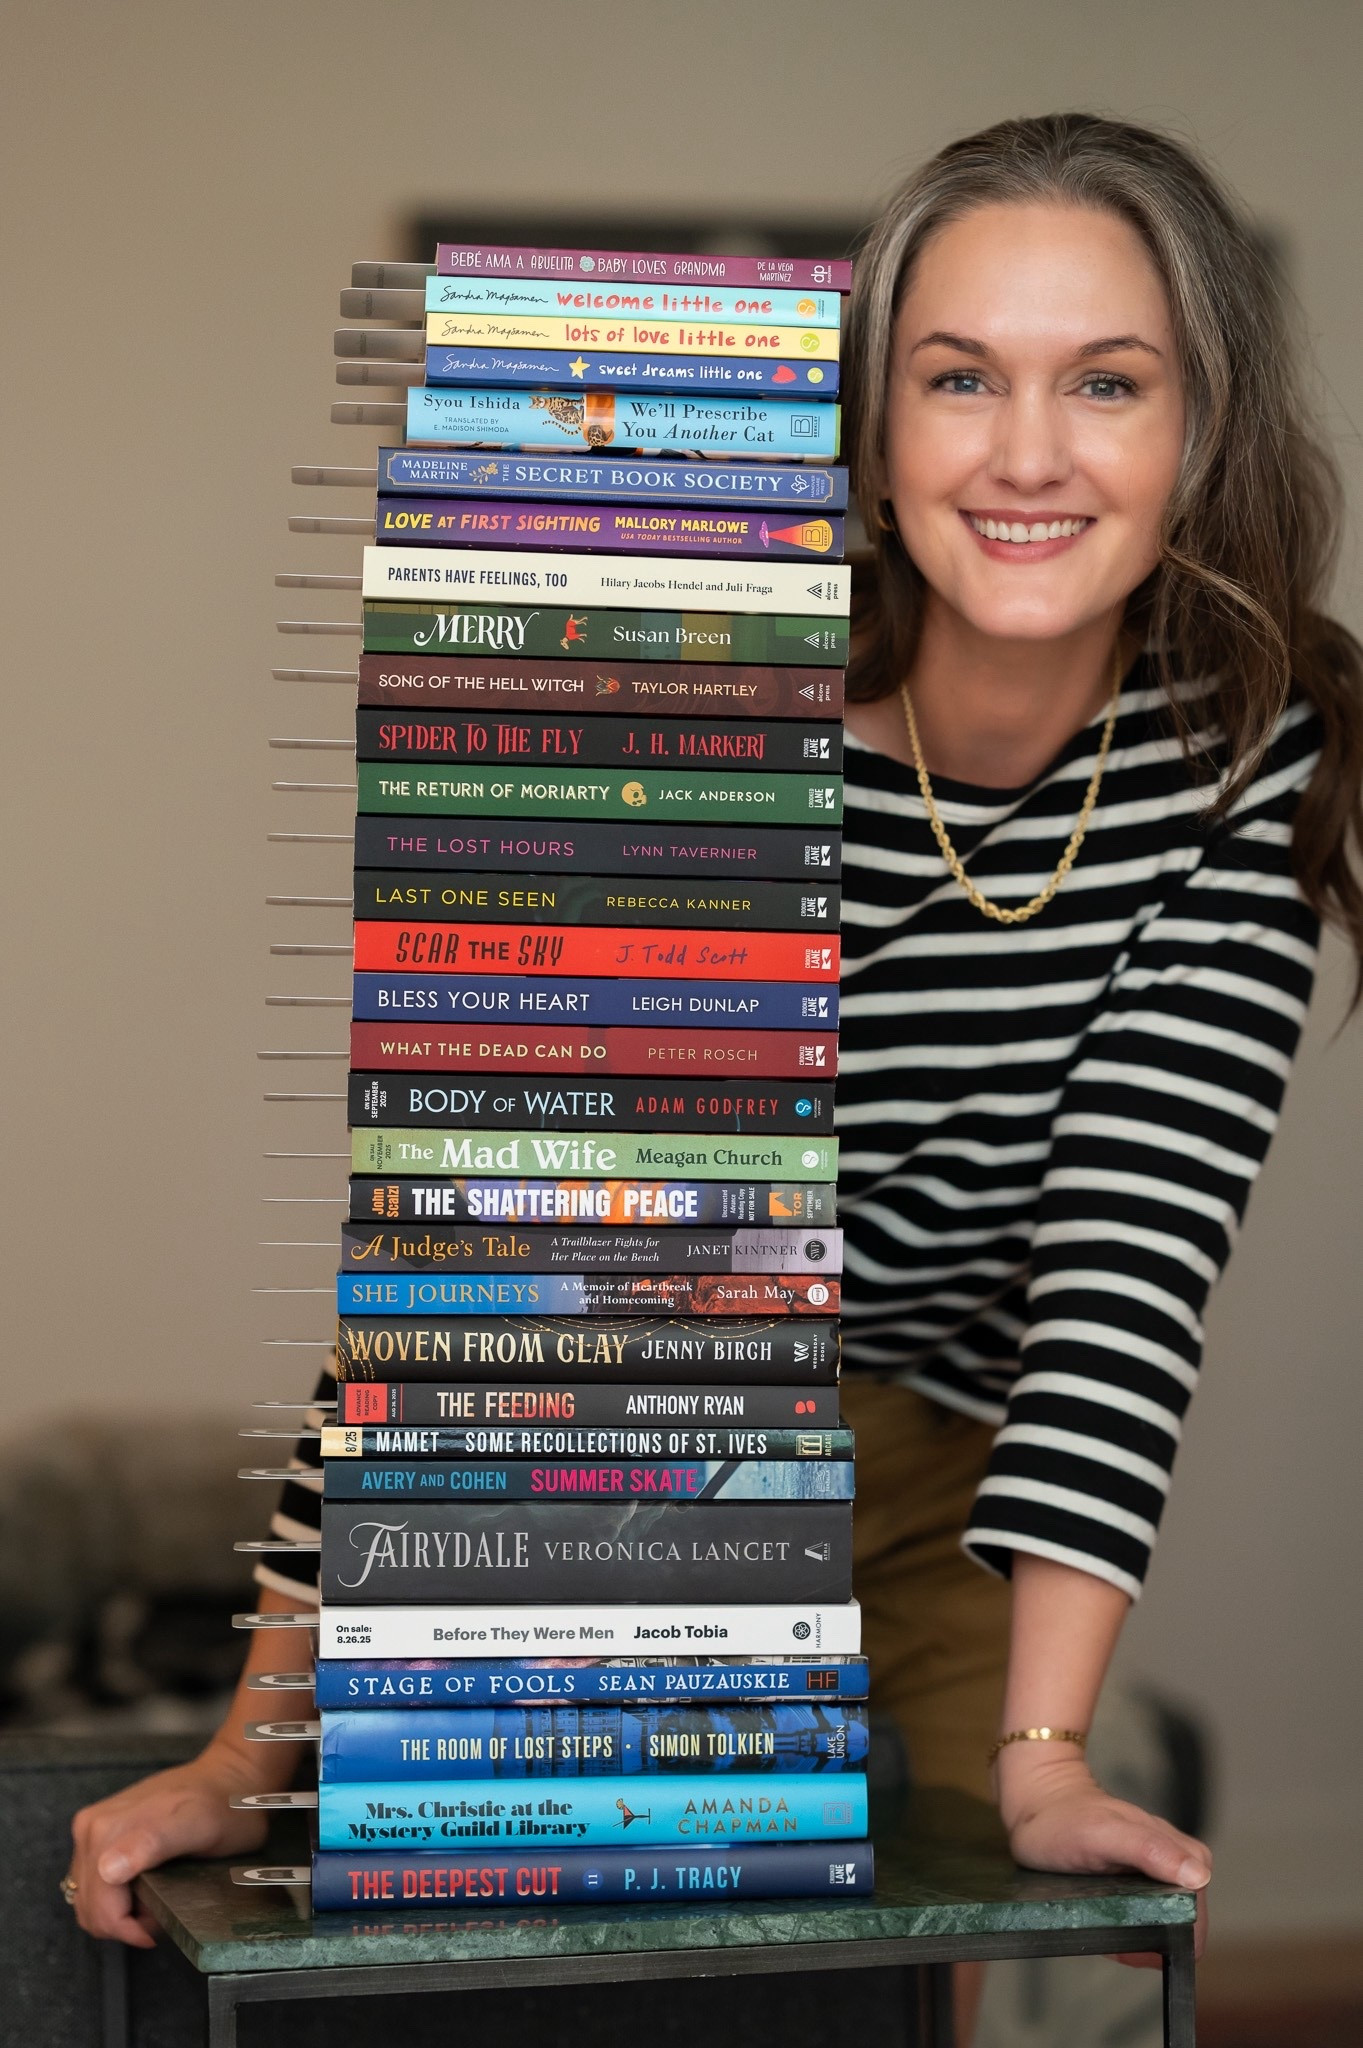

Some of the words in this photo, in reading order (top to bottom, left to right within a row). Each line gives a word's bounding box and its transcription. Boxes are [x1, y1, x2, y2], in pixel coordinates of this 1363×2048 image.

[451, 251, 482, 267] BEBÉ
[486, 254, 511, 268] AMA
[516, 255, 524, 268] A
[531, 255, 573, 270] ABUELITA
[758, 262, 765, 270] DE
[768, 262, 775, 271] LA
[778, 262, 793, 271] VEGA
[760, 272, 792, 282] MARTÍNEZ
[811, 266, 828, 283] dp
[440, 286, 483, 302] Sandra
[557, 292, 654, 310] welcome
[662, 294, 723, 313] little
[735, 300, 772, 313] one
[599, 363, 637, 376] sweet
[642, 364, 694, 378] dreams
[700, 366, 732, 379] little
[737, 369, 763, 380] one
[424, 394, 463, 411] Syou
[470, 395, 521, 410] Ishida
[630, 402, 675, 417] We’ll
[682, 404, 767, 421] Prescribe
[622, 421, 656, 438] You
[663, 424, 737, 441] Another
[744, 428, 774, 442] Cat
[402, 460, 468, 471] MADELINE
[410, 470, 459, 480] MARTIN
[515, 466, 602, 484] SECRET
[611, 470, 676, 487] BOOK
[684, 473, 783, 492] SOCIETY
[614, 516, 677, 530] MALLORY
[681, 520, 748, 533] MARLOWE
[663, 535, 711, 543] BESTSELLING
[388, 567, 441, 582] PARENTS
[445, 570, 475, 584] HAVE
[480, 571, 540, 588] FEELINGS,
[545, 573, 568, 587] TOO
[601, 577, 631, 590] Hilary
[633, 578, 666, 589] Jacobs
[668, 580, 703, 590] Hendel
[706, 581, 723, 591] and
[725, 582, 743, 592] Juli
[746, 583, 773, 595] Fraga
[413, 612, 540, 650] MERRY
[613, 626, 669, 643] Susan
[675, 628, 731, 645] Breen
[379, 724, 457, 754] SPIDER
[461, 724, 487, 754] TO
[492, 724, 531, 755] THE
[542, 728, 584, 755] FLY
[622, 732, 640, 755] J.
[651, 733, 669, 756] H.
[679, 734, 767, 760] MARKERT
[809, 738, 819, 758] LANE
[396, 931, 460, 964] SCAR
[468, 941, 509, 960] THE
[518, 935, 564, 966] SKY
[616, 944, 634, 964] J.
[642, 944, 687, 965] Todd
[696, 947, 748, 965] Scott
[378, 990, 438, 1008] BLESS
[448, 991, 509, 1010] YOUR
[520, 993, 590, 1011] HEART
[632, 997, 682, 1011] LEIGH
[690, 998, 759, 1012] DUNLAP
[410, 1088, 486, 1114] BODY
[493, 1097, 516, 1112] OF
[524, 1091, 616, 1116] WATER
[636, 1096, 685, 1114] ADAM
[697, 1098, 779, 1115] GODFREY
[372, 1188, 385, 1215] John
[411, 1188, 455, 1215] THE
[468, 1188, 610, 1217] SHATTERING
[624, 1190, 697, 1218] PEACE
[794, 1192, 802, 1215] TOR
[351, 1234, 385, 1260] A
[482, 1235, 530, 1258] Tale
[550, 1238, 558, 1246] A
[561, 1237, 612, 1247] Trailblazer
[615, 1237, 643, 1248] Fights
[645, 1238, 660, 1248] for
[687, 1244, 730, 1257] JANET
[735, 1245, 798, 1255] KINTNER
[810, 1242, 820, 1259] SWP
[551, 1252, 568, 1261] Her
[572, 1252, 596, 1262] Place
[613, 1253, 628, 1262] the
[631, 1253, 659, 1262] Bench
[352, 1284, 398, 1302] SHE
[406, 1284, 540, 1308] JOURNEYS
[561, 1282, 568, 1291] A
[572, 1282, 615, 1291] Memoir
[617, 1282, 629, 1291] of
[632, 1282, 692, 1292] Heartbreak
[717, 1286, 758, 1298] Sarah
[765, 1286, 795, 1304] May
[579, 1295, 599, 1304] and
[603, 1296, 675, 1307] Homecoming
[347, 1331, 450, 1361] WOVEN
[464, 1332, 545, 1363] FROM
[557, 1333, 628, 1364] CLAY
[642, 1340, 706, 1360] JENNY
[714, 1341, 772, 1361] BIRCH
[437, 1391, 475, 1418] THE
[485, 1392, 575, 1419] FEEDING
[626, 1395, 699, 1415] ANTHONY
[704, 1396, 744, 1416] RYAN
[345, 1432, 357, 1452] 8/25
[338, 1521, 529, 1587] FAIRYDALE
[544, 1541, 682, 1561] VERONICA
[692, 1542, 790, 1561] LANCET
[336, 1625, 348, 1633] On
[350, 1625, 372, 1633] sale:
[634, 1625, 681, 1639] Jacob
[685, 1625, 728, 1638] Tobia
[337, 1636, 371, 1644] 8.26.25
[808, 1671, 837, 1688] HF
[650, 1734, 700, 1757] SIMON
[707, 1733, 774, 1756] TOLKIEN
[827, 1735, 836, 1759] LAKE
[836, 1724, 845, 1758] UNION
[684, 1798, 789, 1815] AMANDA
[677, 1818, 797, 1834] CHAPMAN
[348, 1870, 394, 1900] THE
[403, 1868, 508, 1899] DEEPEST
[516, 1866, 562, 1896] CUT
[624, 1868, 641, 1890] P.
[651, 1868, 666, 1890] J.
[676, 1866, 741, 1889] TRACY
